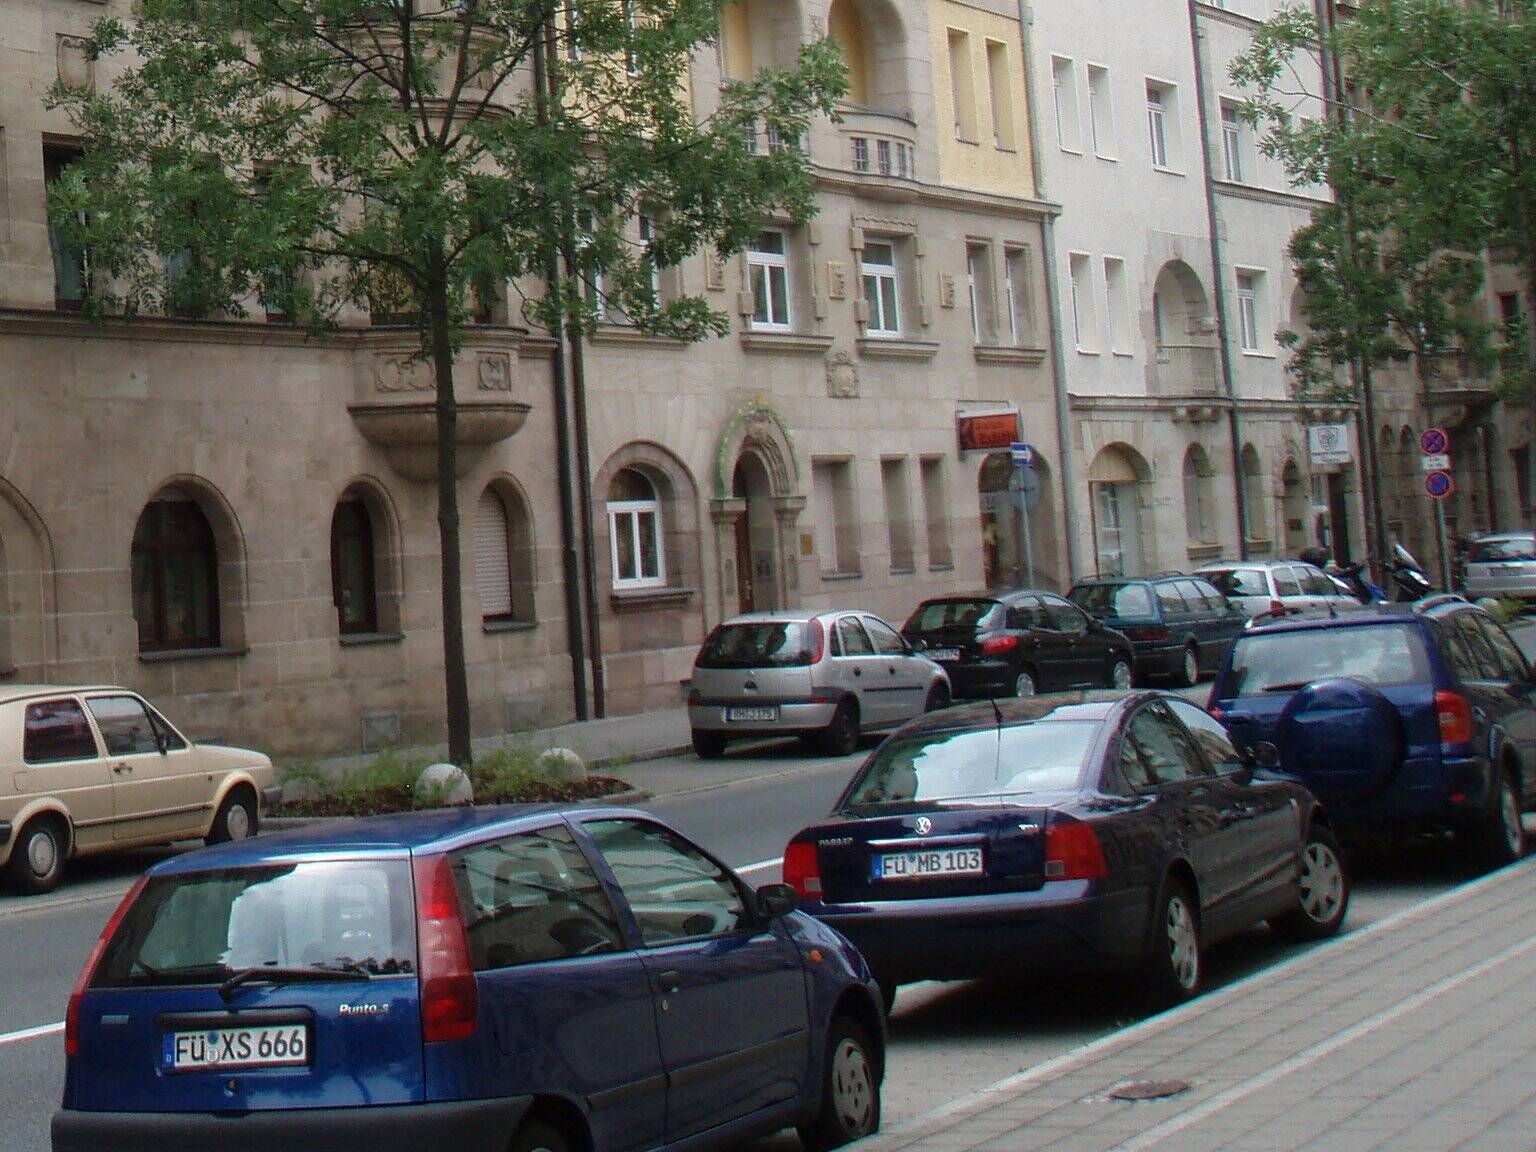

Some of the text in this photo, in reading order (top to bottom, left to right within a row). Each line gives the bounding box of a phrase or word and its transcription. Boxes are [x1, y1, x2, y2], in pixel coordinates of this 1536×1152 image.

[883, 851, 980, 874] FÜ MB 103
[340, 1003, 377, 1014] Punto
[176, 1030, 304, 1062] FÜ XS 666
